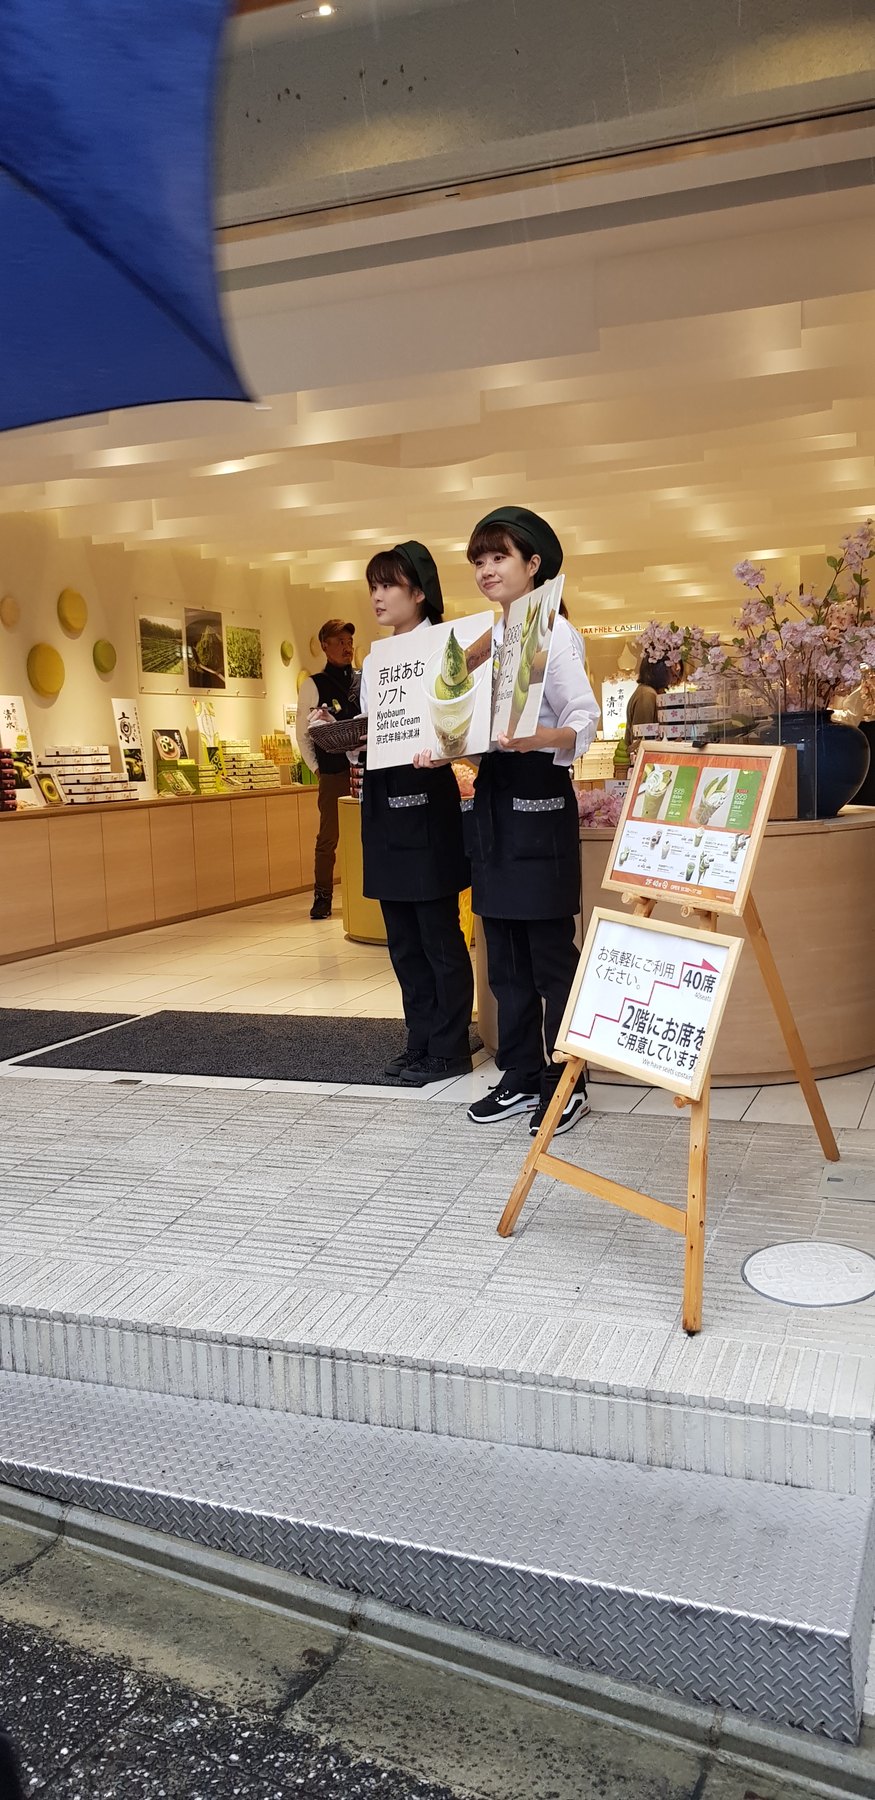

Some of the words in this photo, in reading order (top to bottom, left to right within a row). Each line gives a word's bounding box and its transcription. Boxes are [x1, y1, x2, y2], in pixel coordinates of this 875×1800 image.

[378, 659, 425, 686] 京ばあむ
[378, 685, 407, 706] ソフト
[376, 708, 406, 721] Kyobaum
[376, 720, 390, 731] Soft
[390, 719, 399, 728] Ice
[400, 715, 420, 727] Cream
[597, 946, 676, 979] お気軽にご利用
[595, 964, 641, 990] ください。
[682, 969, 717, 994] 40席
[621, 1004, 706, 1051] 2階にお席を
